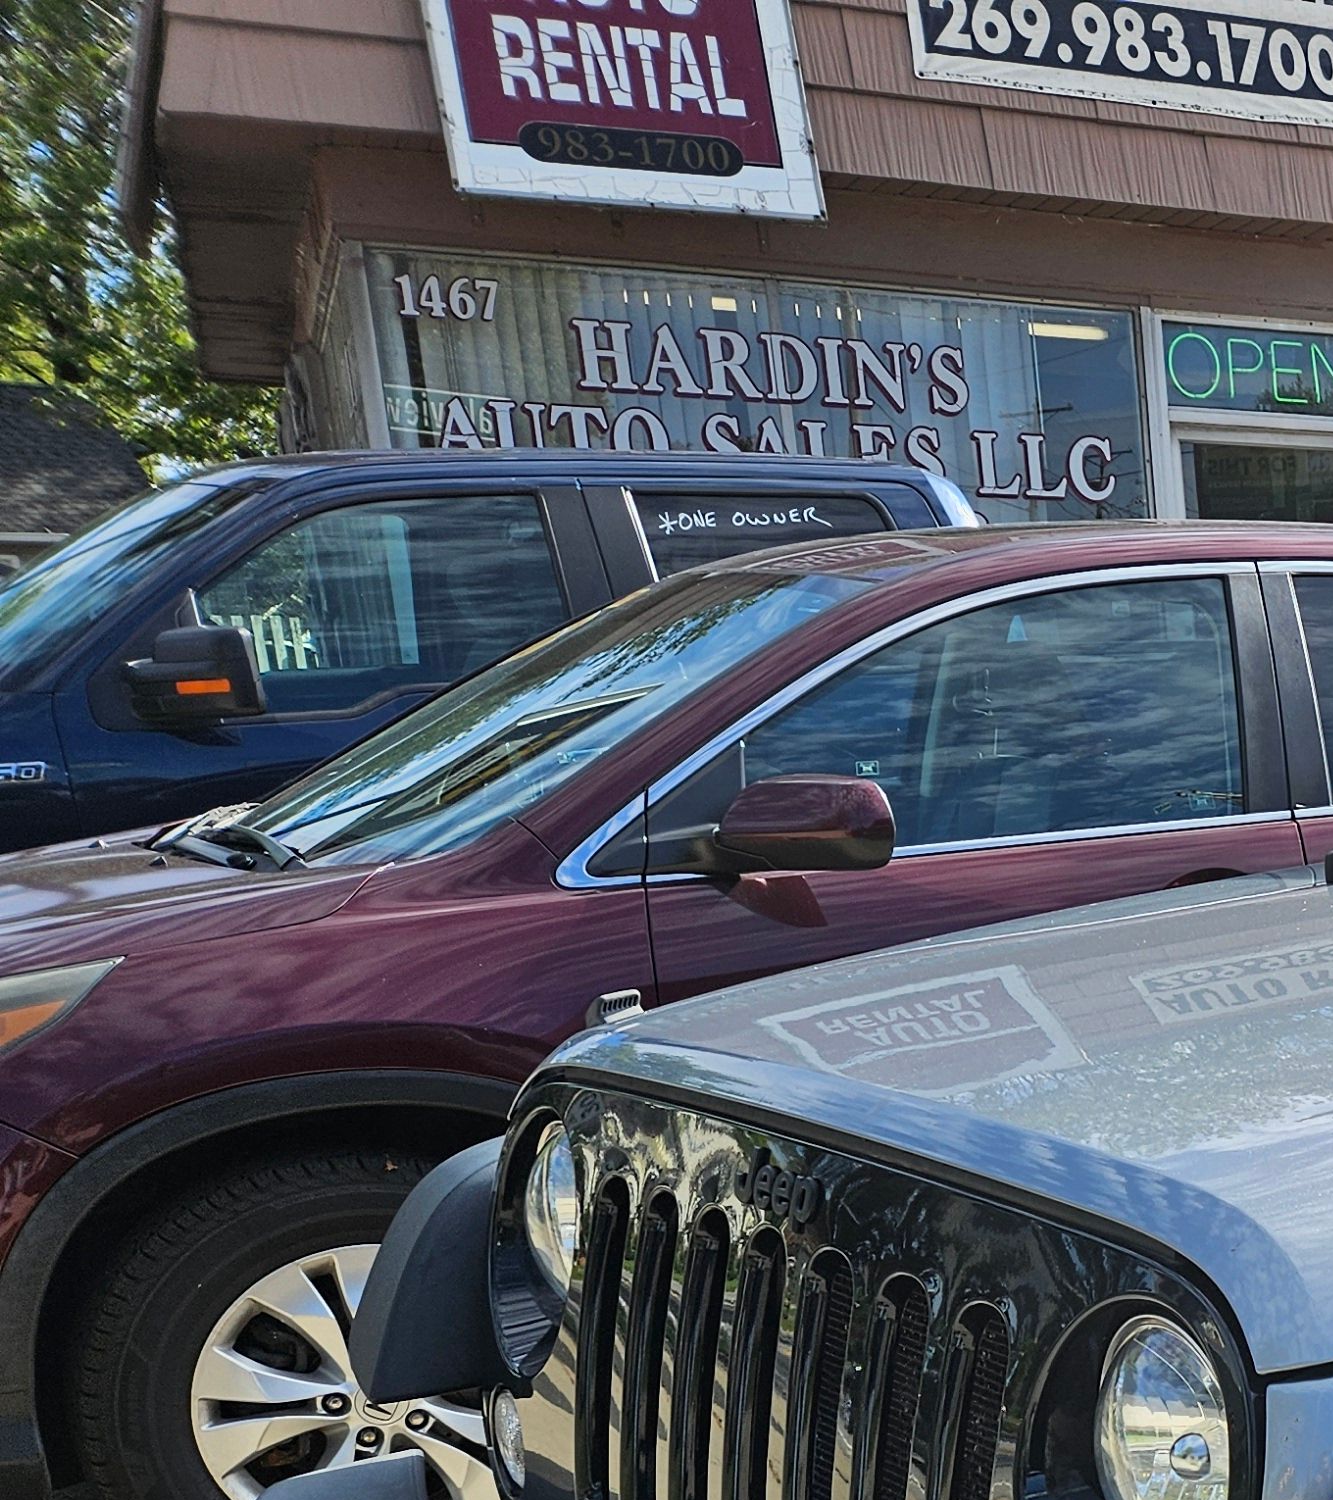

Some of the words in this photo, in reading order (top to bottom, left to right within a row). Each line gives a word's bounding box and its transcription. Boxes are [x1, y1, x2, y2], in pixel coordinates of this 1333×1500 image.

[489, 13, 748, 118] RENTAL
[537, 126, 730, 172] 983-1700
[394, 273, 499, 321] 1467
[570, 317, 970, 417] HARDIN'S
[439, 396, 671, 449] AUTO
[971, 430, 1116, 502] LLC
[732, 506, 834, 529] OWNER
[735, 1146, 820, 1233] Jeep
